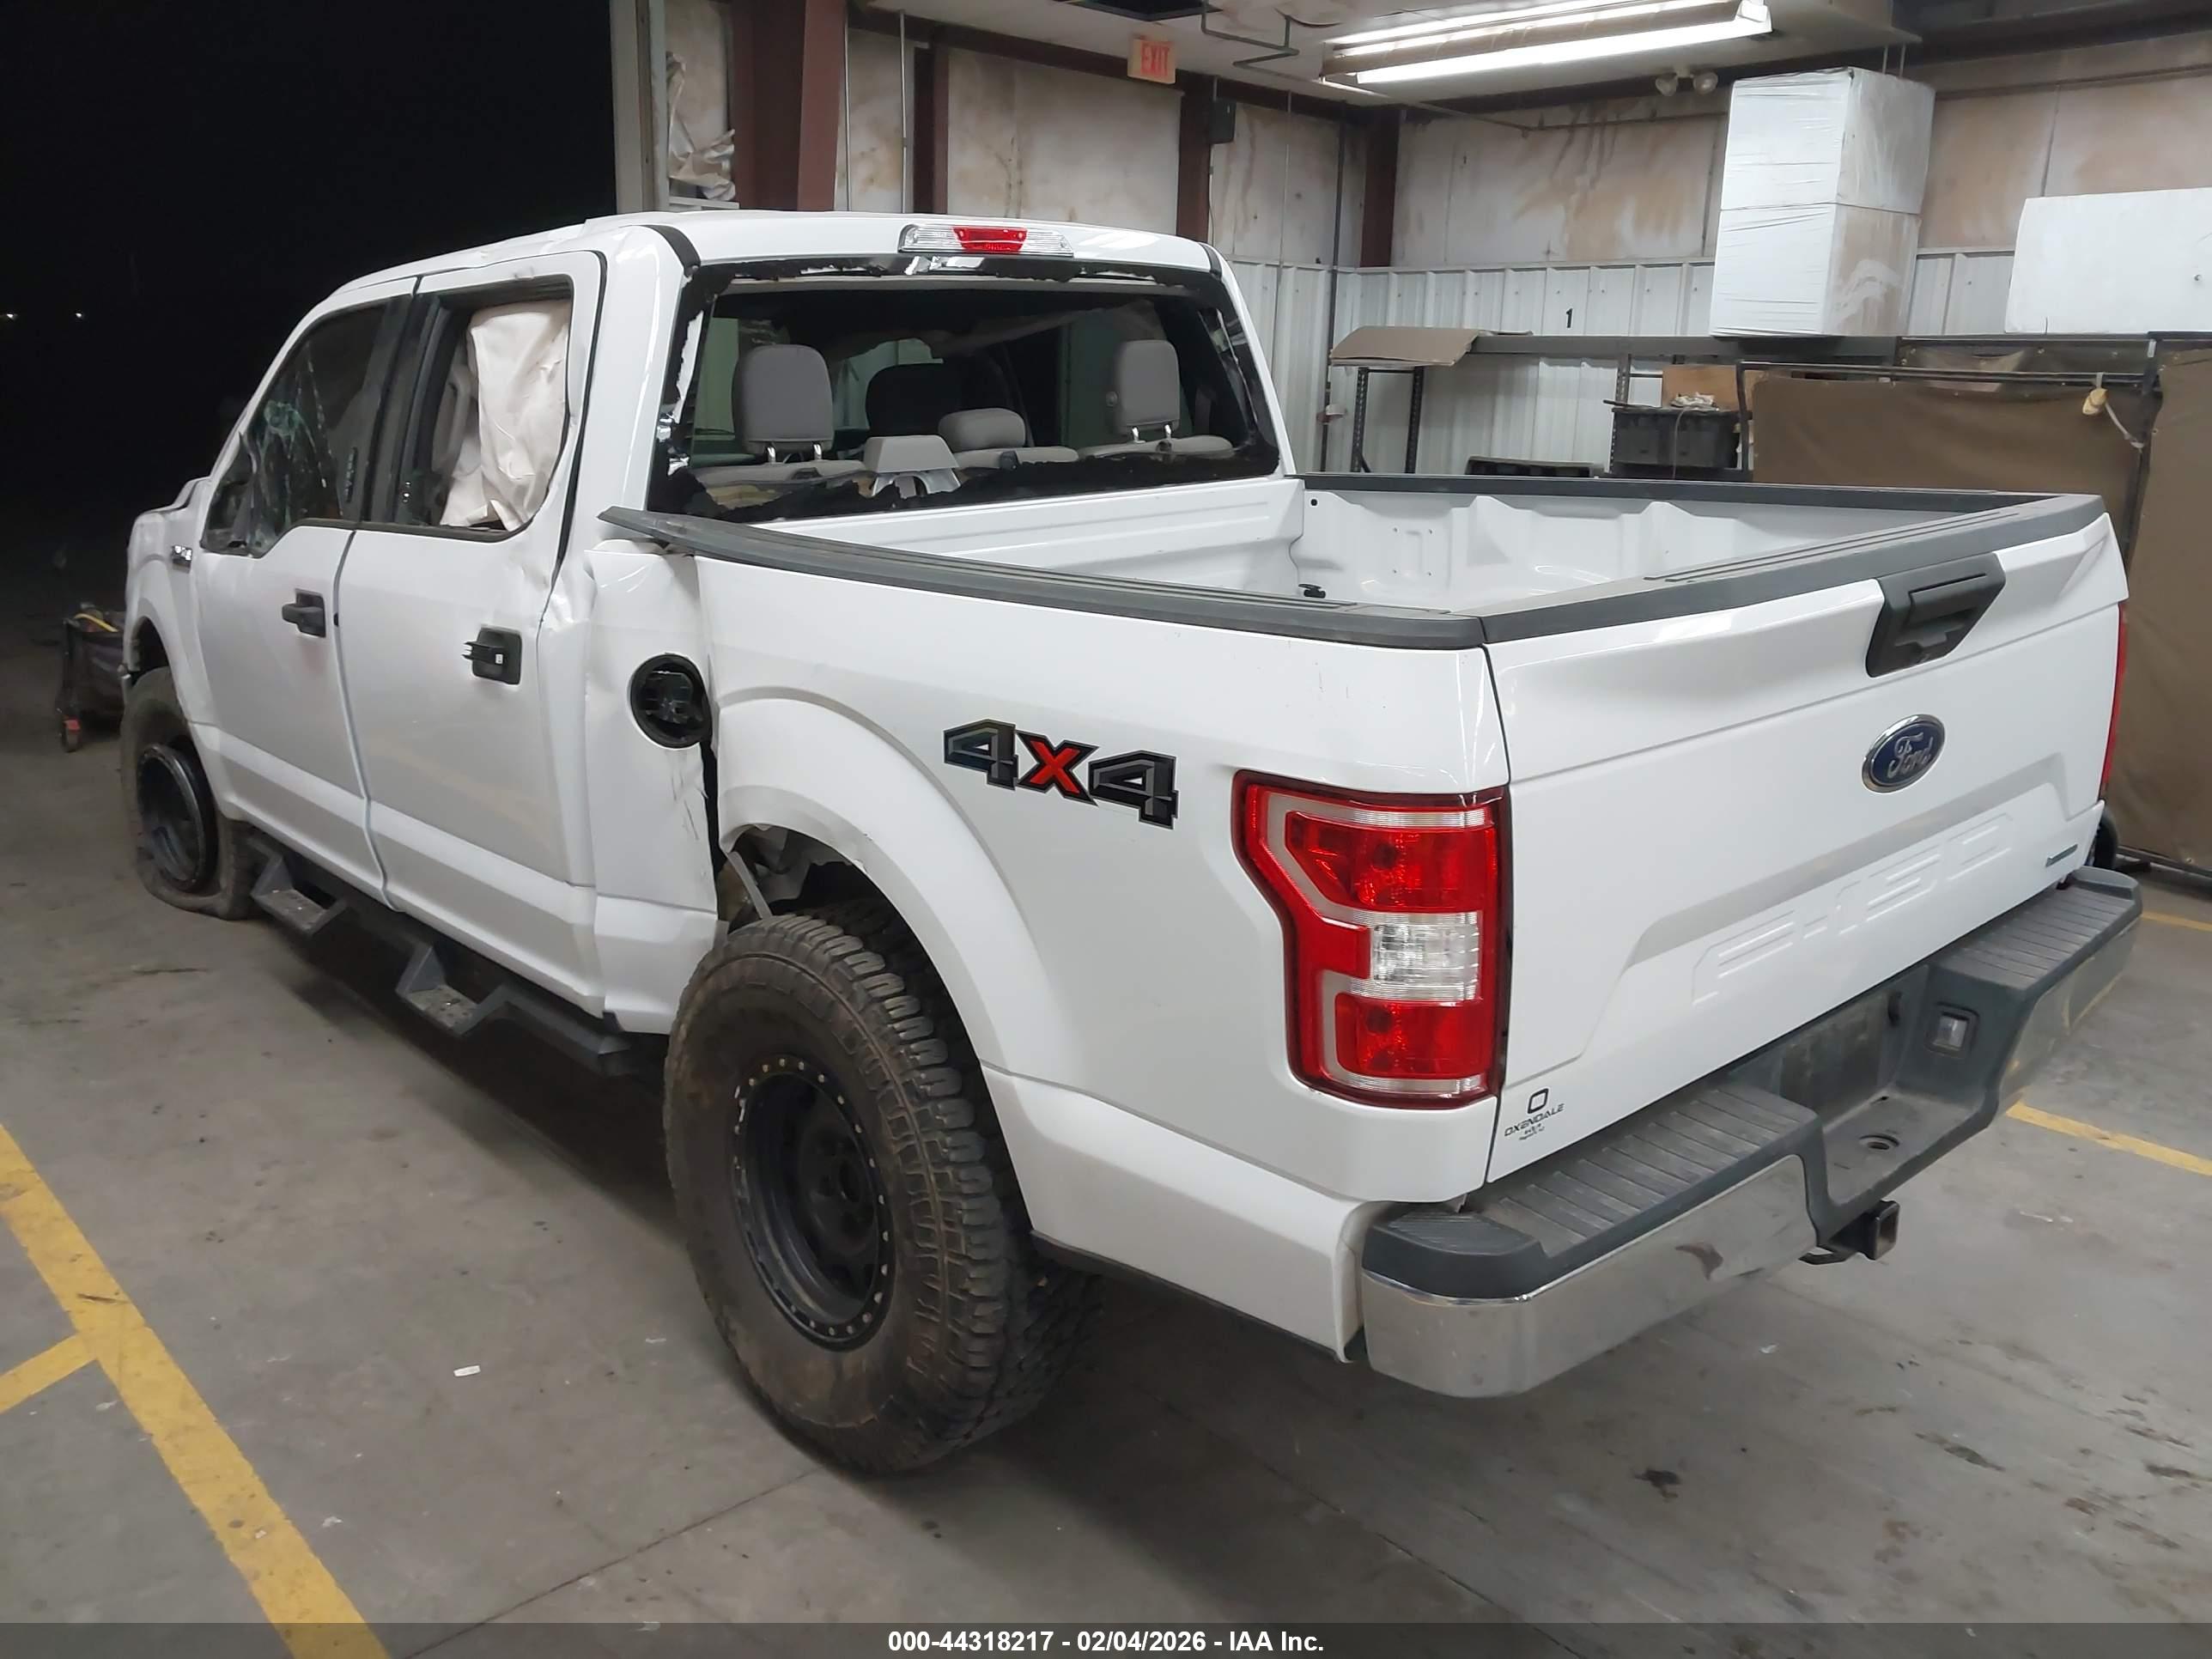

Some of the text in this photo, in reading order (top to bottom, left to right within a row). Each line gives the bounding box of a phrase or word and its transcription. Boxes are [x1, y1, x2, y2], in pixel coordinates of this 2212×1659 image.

[1140, 41, 1170, 76] EXIT
[1565, 307, 1573, 329] 1
[1887, 732, 1934, 779] Ford
[1504, 1103, 1565, 1137] OXENDALE
